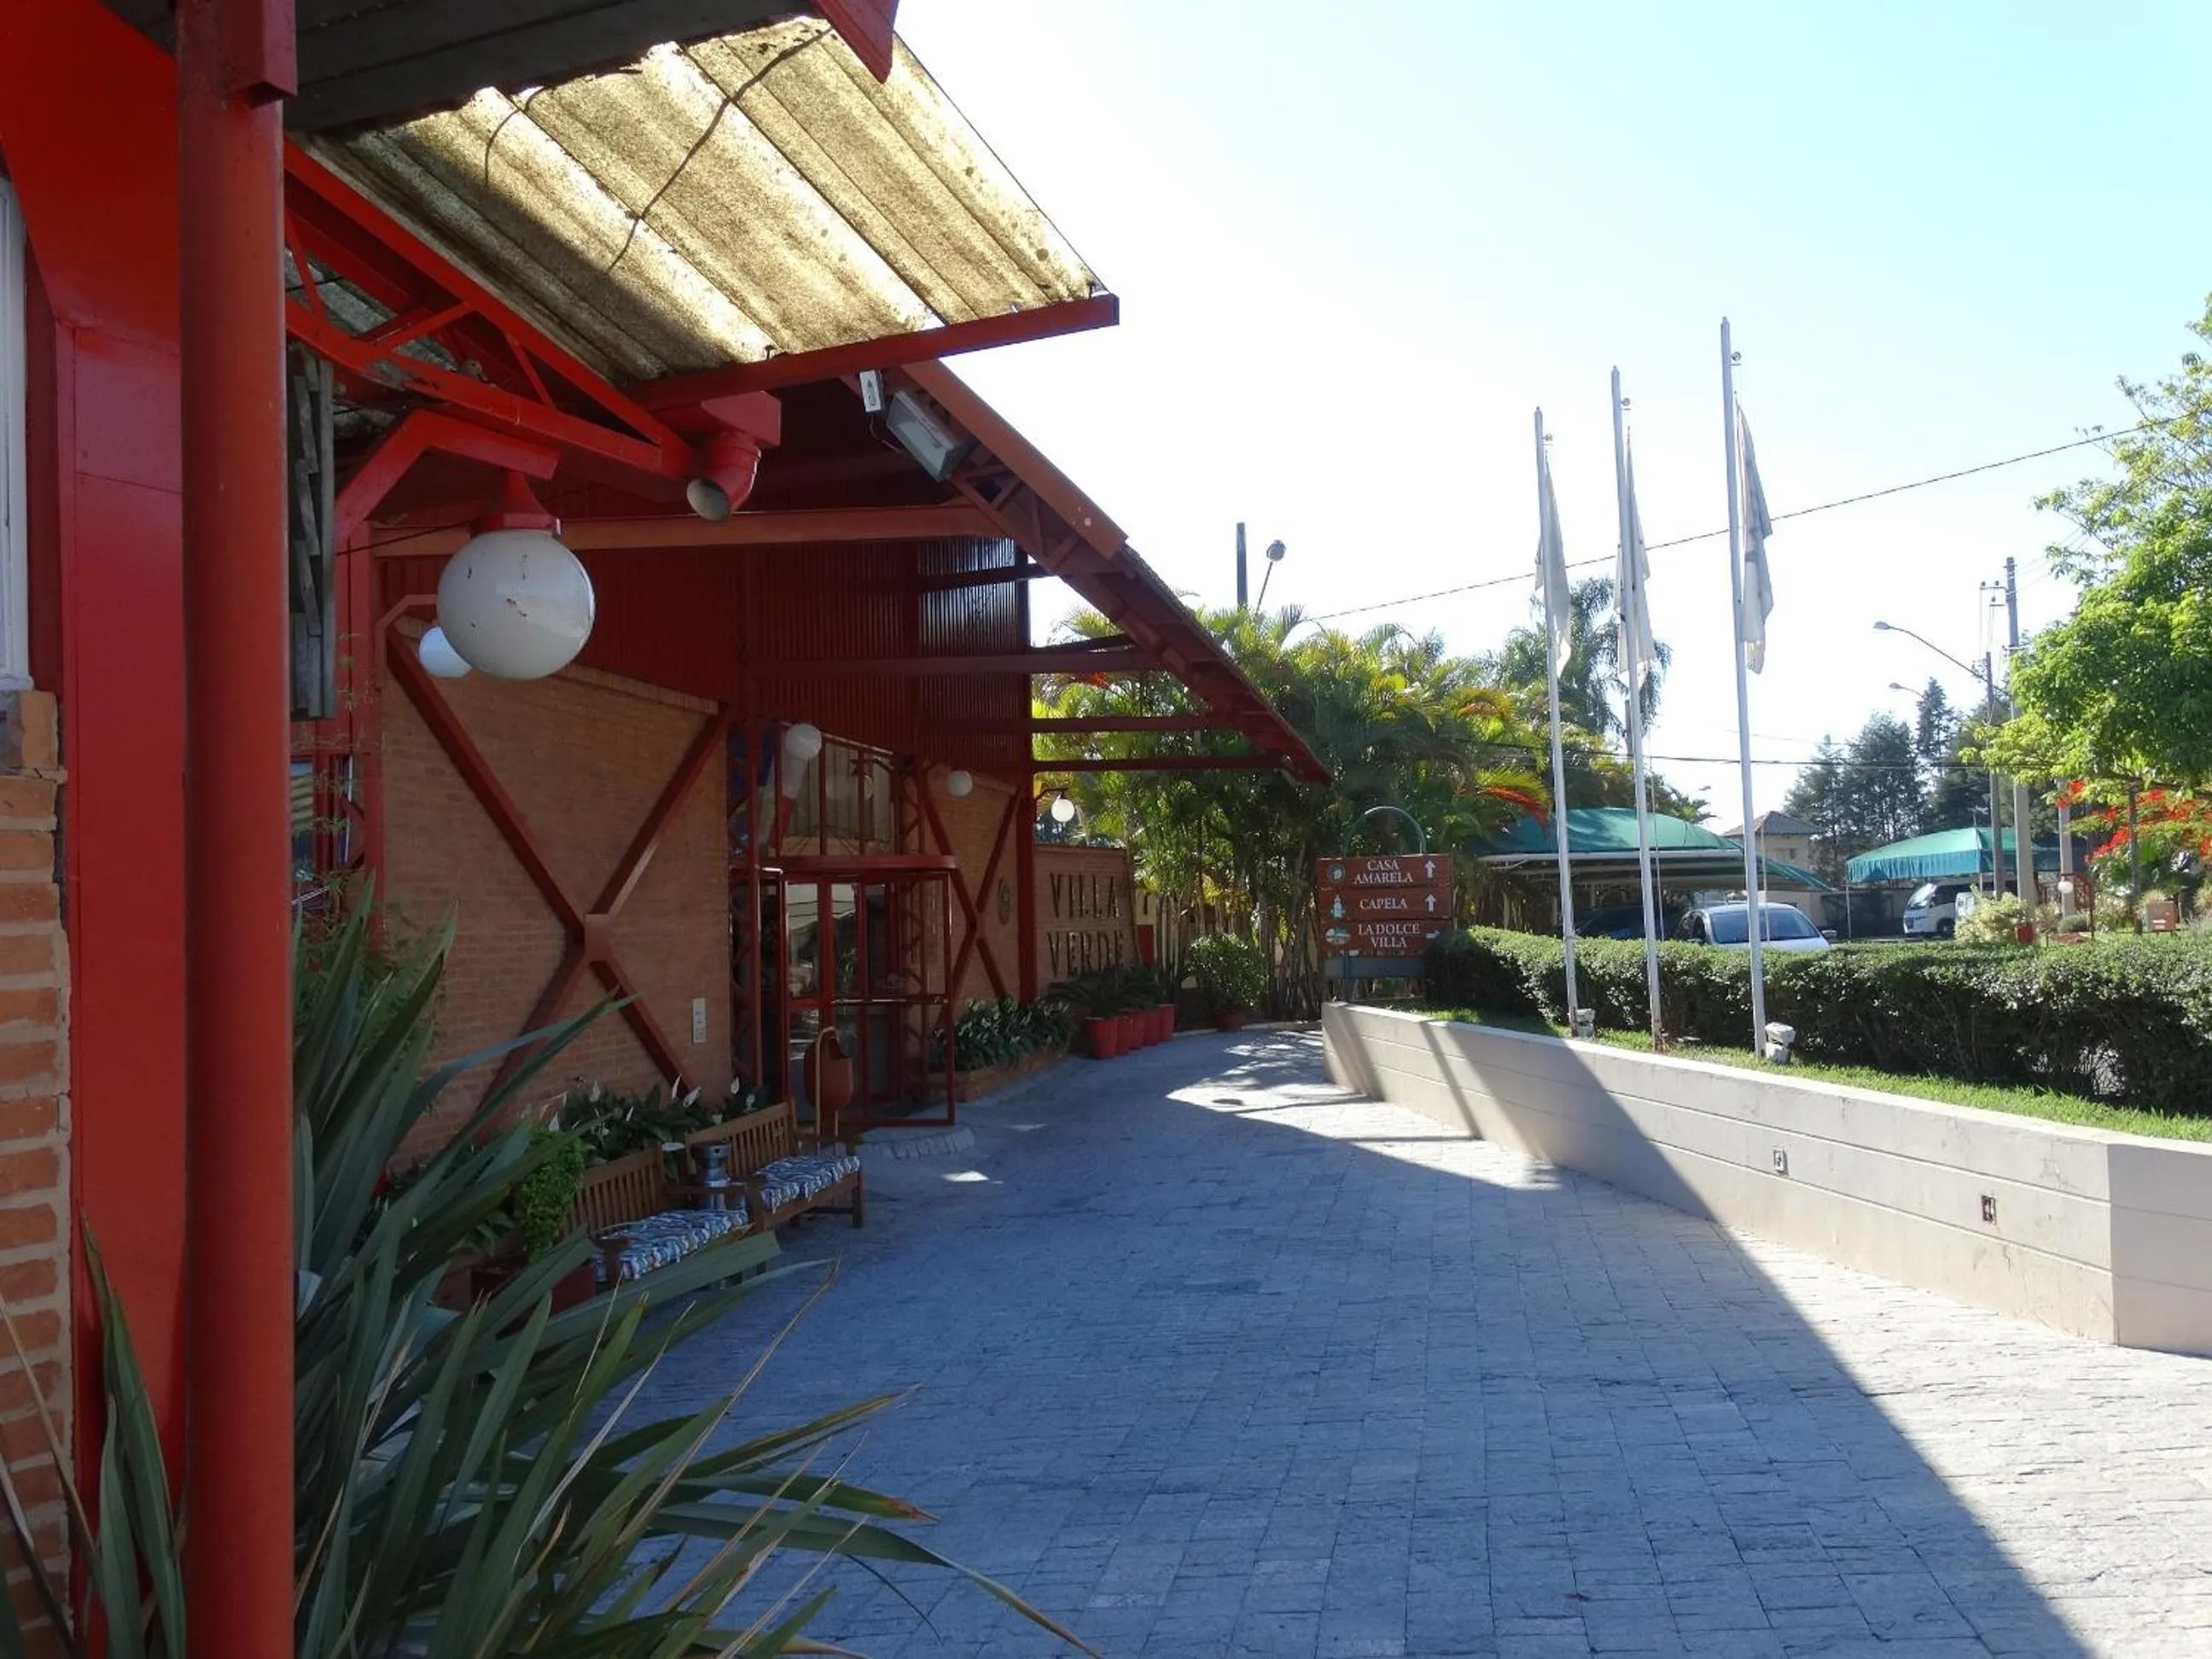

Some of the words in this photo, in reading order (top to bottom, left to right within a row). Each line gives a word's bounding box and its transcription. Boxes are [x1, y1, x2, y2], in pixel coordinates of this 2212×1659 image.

[1367, 859, 1400, 870] CASA
[1354, 872, 1413, 884] AMARELA
[1051, 873, 1119, 917] VILLA
[1359, 898, 1407, 909] CAPELA
[1376, 923, 1420, 934] DOLCE
[1371, 936, 1407, 947] VILLA
[1048, 931, 1124, 977] VERDE
